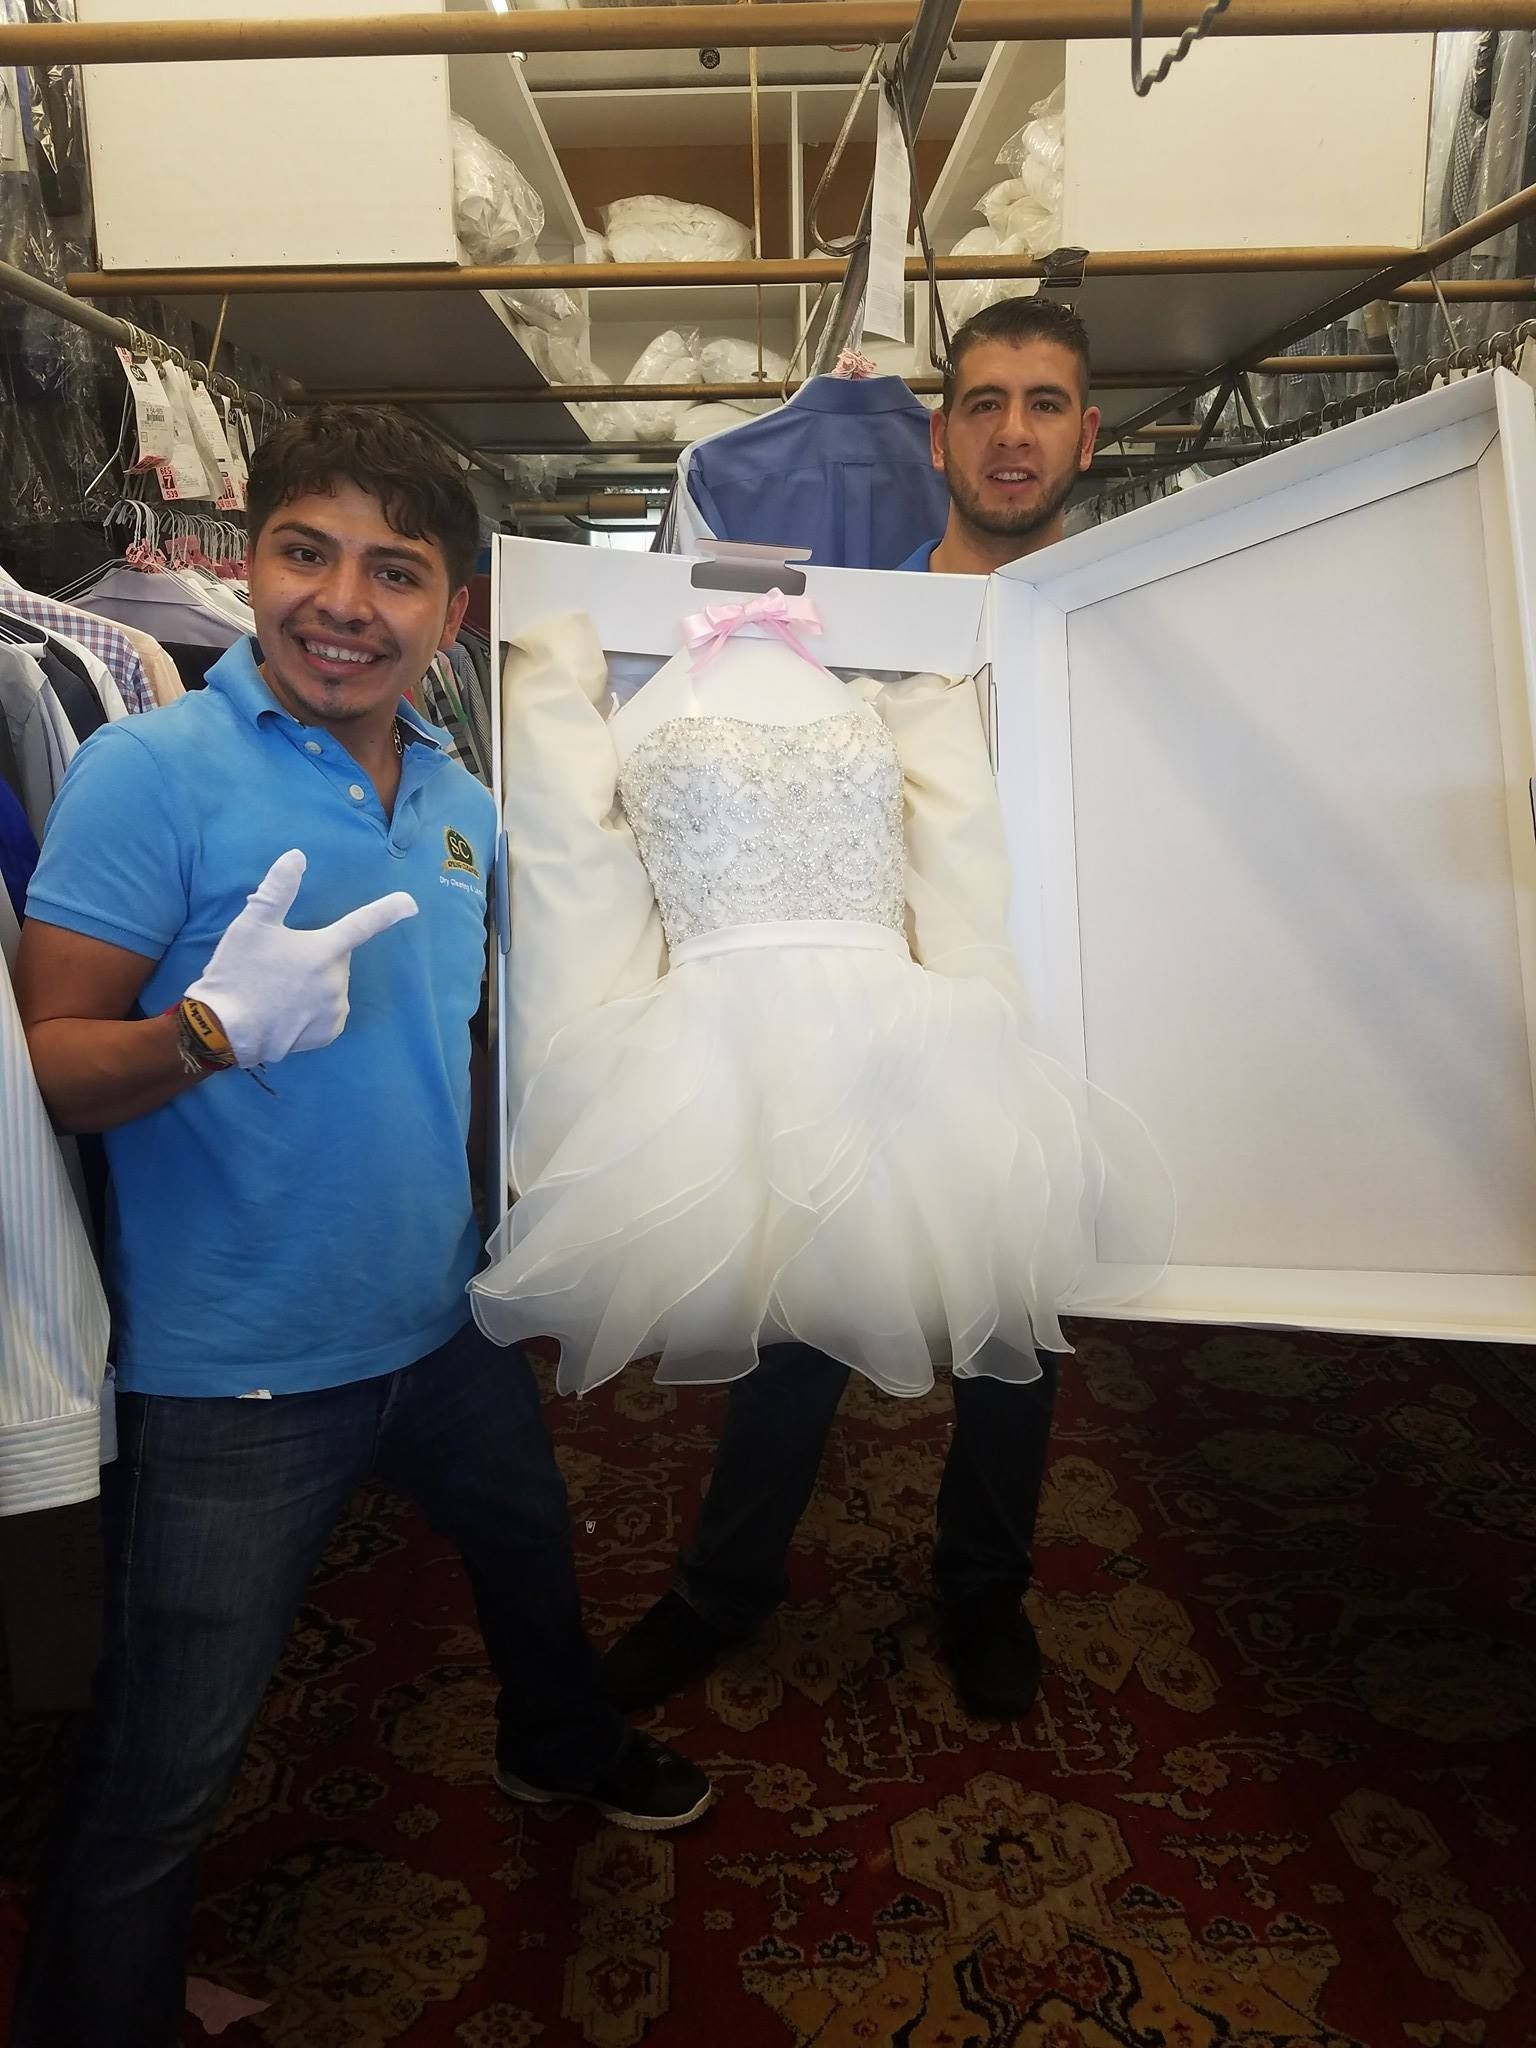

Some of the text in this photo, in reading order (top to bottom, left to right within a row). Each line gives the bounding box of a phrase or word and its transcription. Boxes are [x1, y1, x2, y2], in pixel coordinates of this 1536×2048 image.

[131, 367, 145, 379] SC
[166, 490, 179, 499] 539
[449, 836, 470, 859] SC
